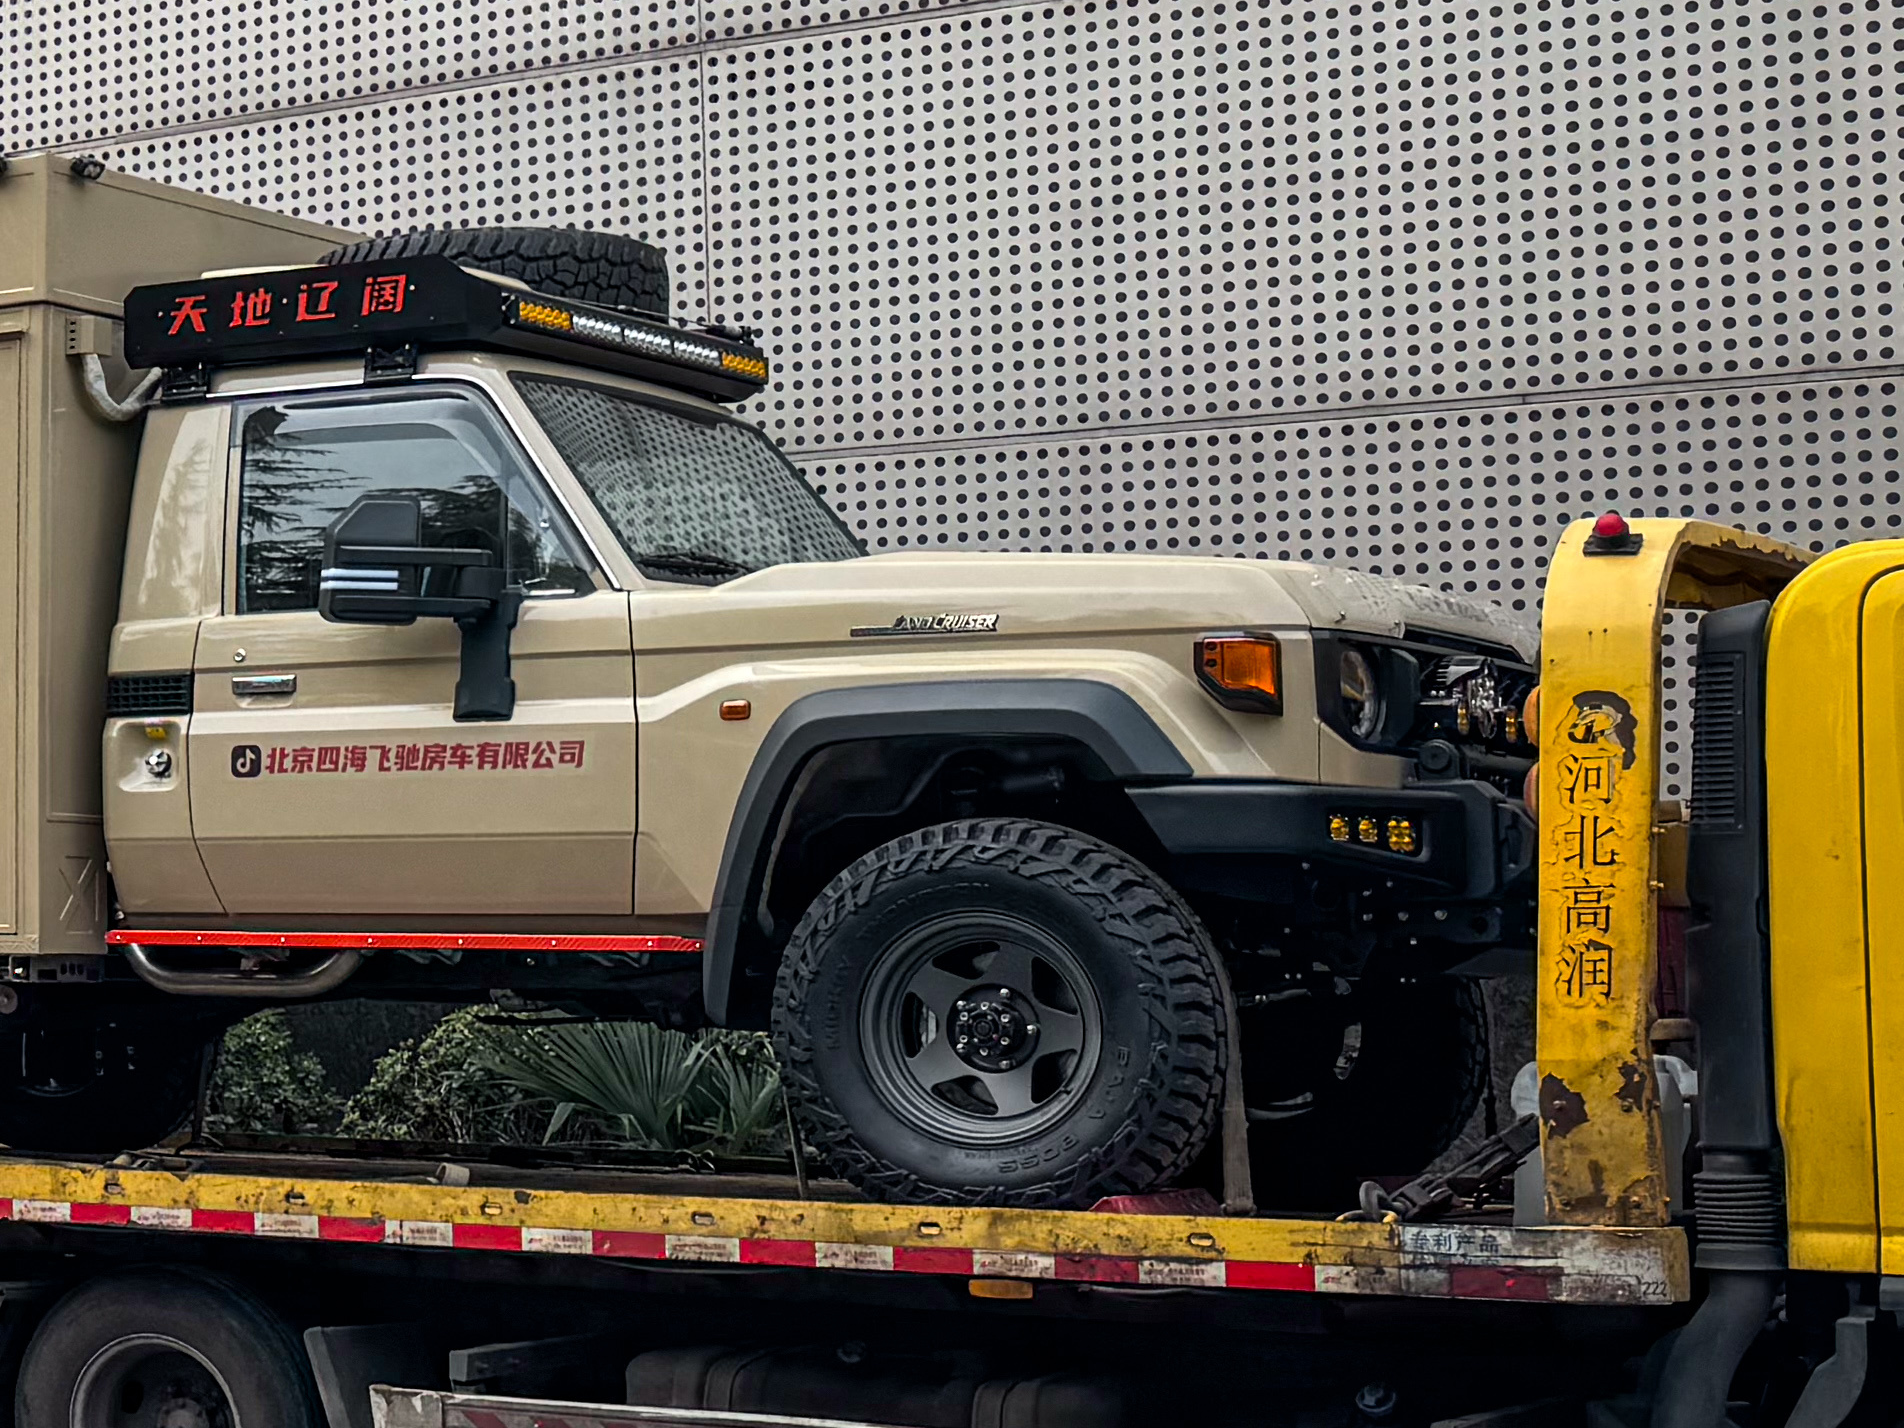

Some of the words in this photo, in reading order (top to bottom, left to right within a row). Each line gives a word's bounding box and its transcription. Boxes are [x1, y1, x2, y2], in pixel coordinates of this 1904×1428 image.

[934, 613, 1000, 631] CRUISER
[264, 739, 586, 775] 北京四海飞驰房车有限公司
[1561, 752, 1619, 1001] 河北高润
